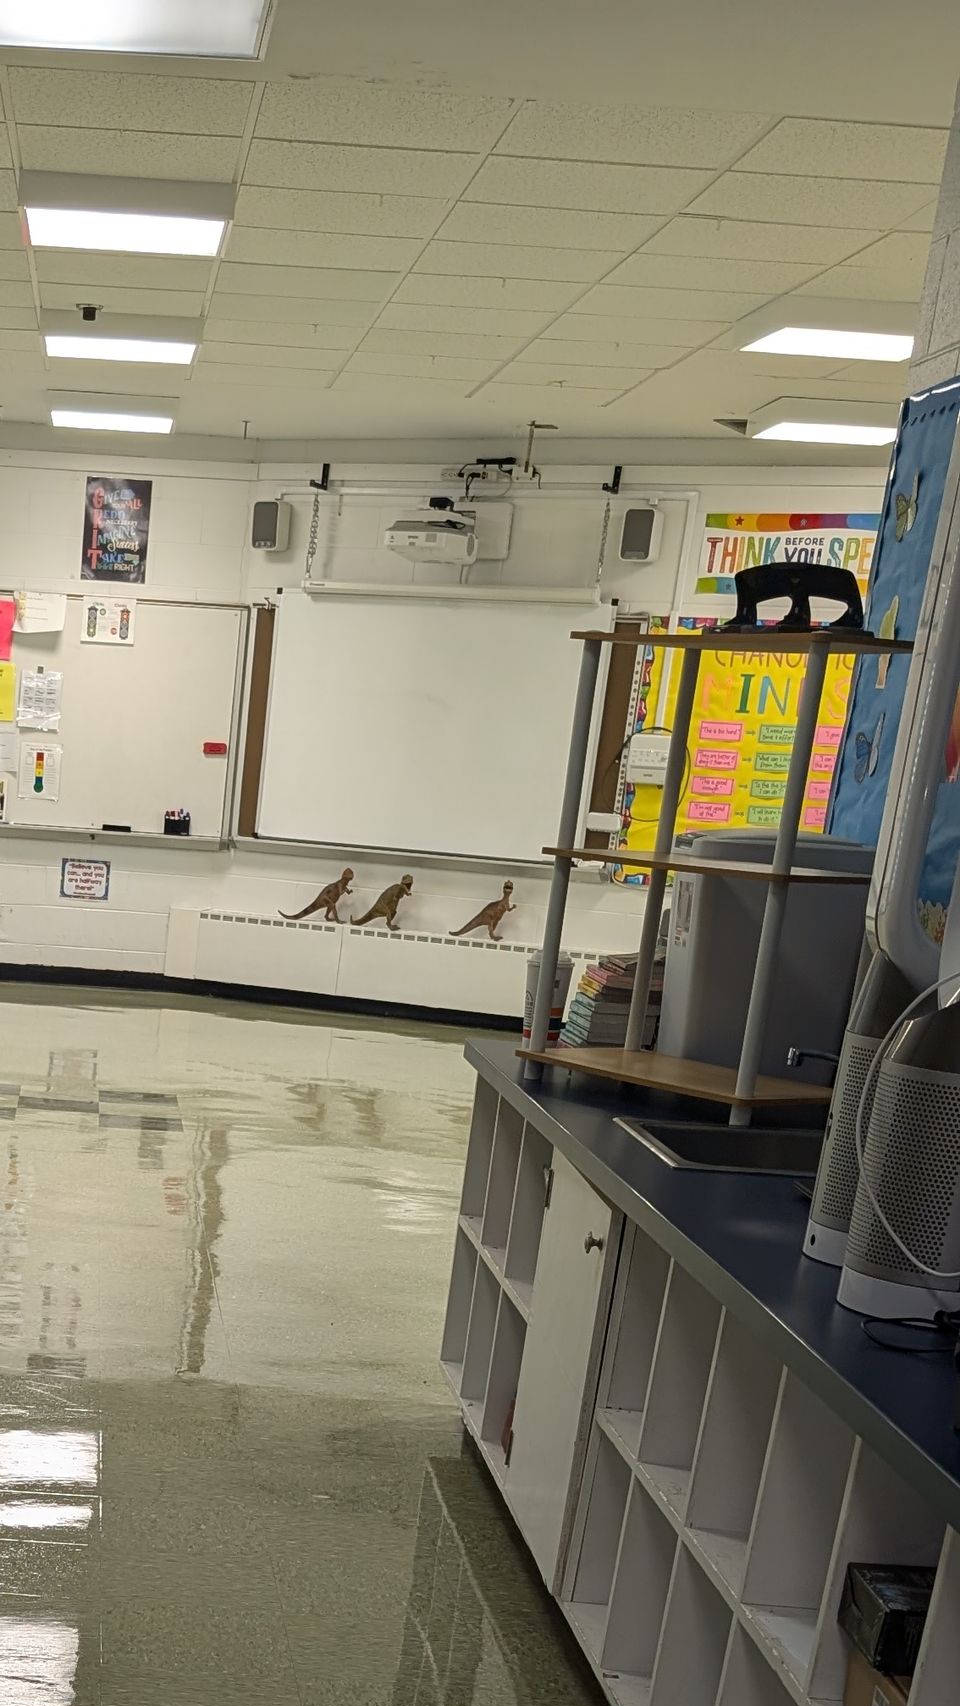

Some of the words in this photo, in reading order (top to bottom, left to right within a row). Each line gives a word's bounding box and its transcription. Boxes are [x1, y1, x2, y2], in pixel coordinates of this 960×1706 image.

[785, 537, 825, 546] BEFORE
[707, 536, 781, 574] THINK
[784, 548, 822, 564] YOU
